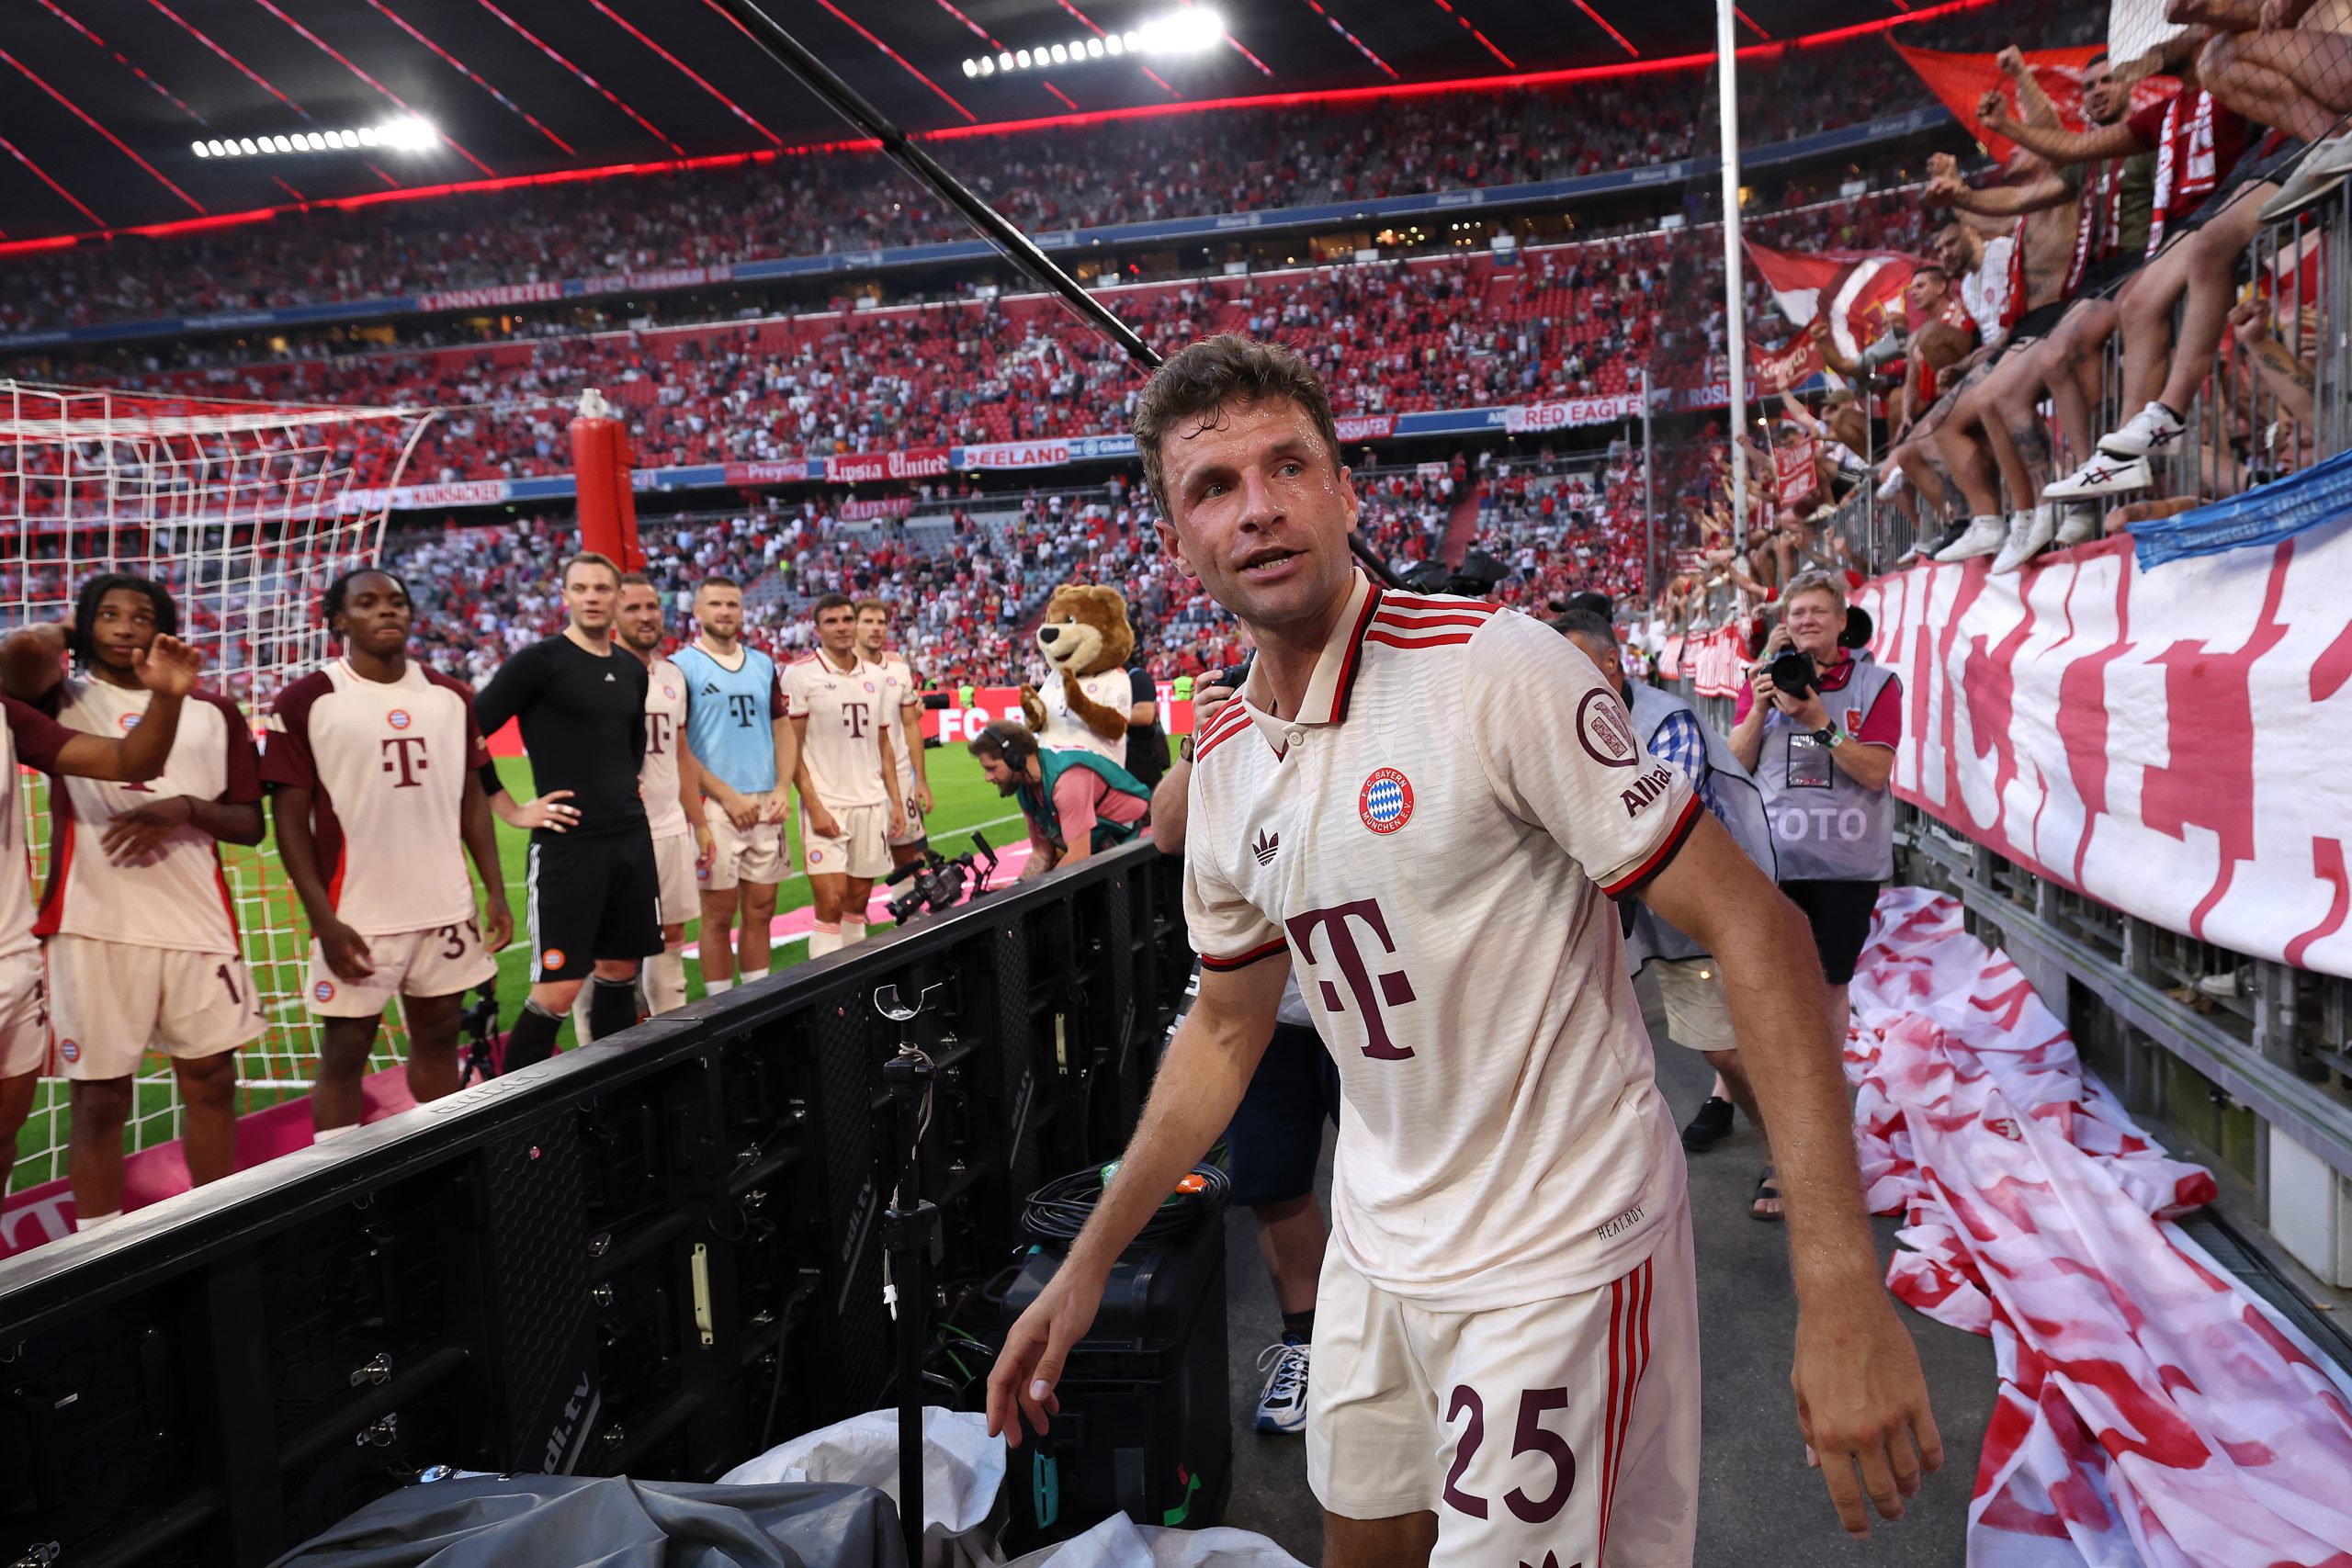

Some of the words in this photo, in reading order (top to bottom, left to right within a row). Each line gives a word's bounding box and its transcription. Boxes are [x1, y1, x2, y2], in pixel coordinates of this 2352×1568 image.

[1525, 408, 1566, 426] RED
[1571, 398, 1645, 422] EAGLE
[888, 450, 950, 479] United
[1375, 770, 1408, 788] BAYERN
[906, 796, 917, 819] 8
[1285, 897, 1417, 1061] T
[1597, 1204, 1645, 1241] HEAT.RDY
[543, 1371, 590, 1475] di.tv
[1442, 1384, 1576, 1524] 25
